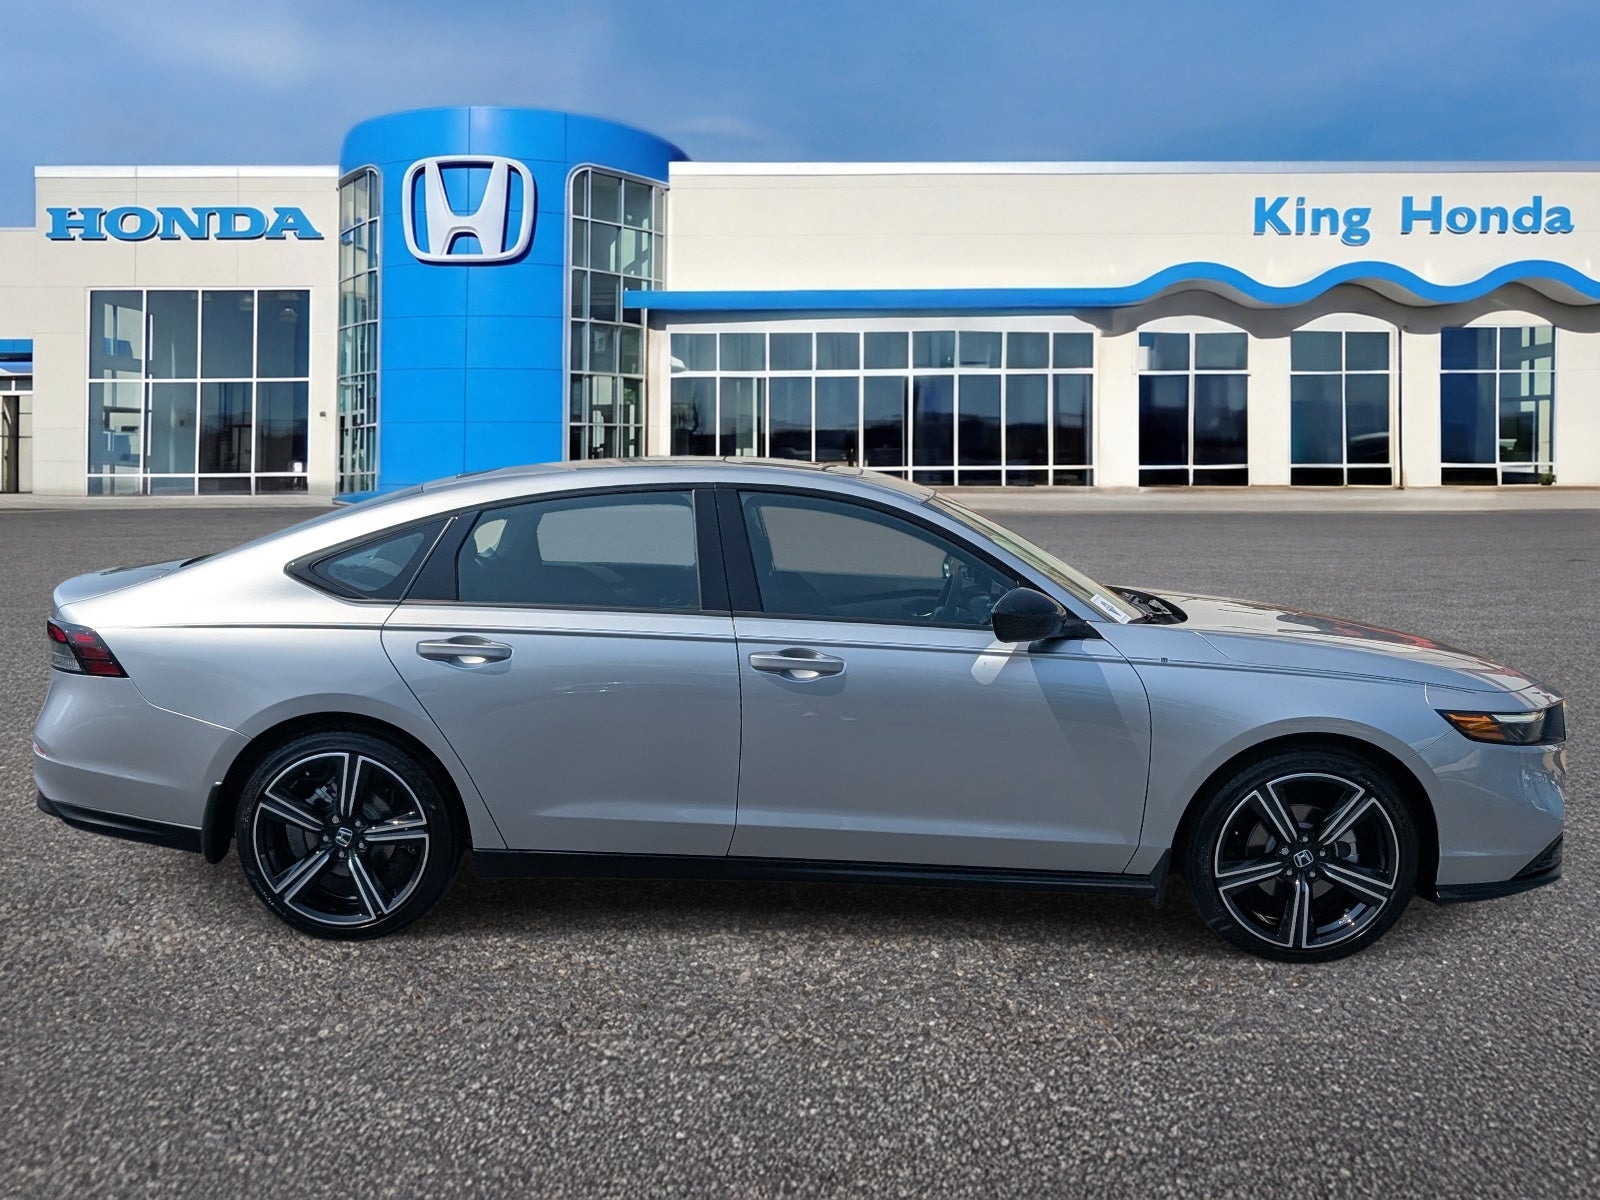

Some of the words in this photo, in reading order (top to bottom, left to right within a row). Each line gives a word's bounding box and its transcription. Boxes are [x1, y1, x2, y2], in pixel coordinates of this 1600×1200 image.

[45, 206, 325, 242] HONDA
[1253, 196, 1372, 246] King
[1400, 195, 1575, 235] Honda
